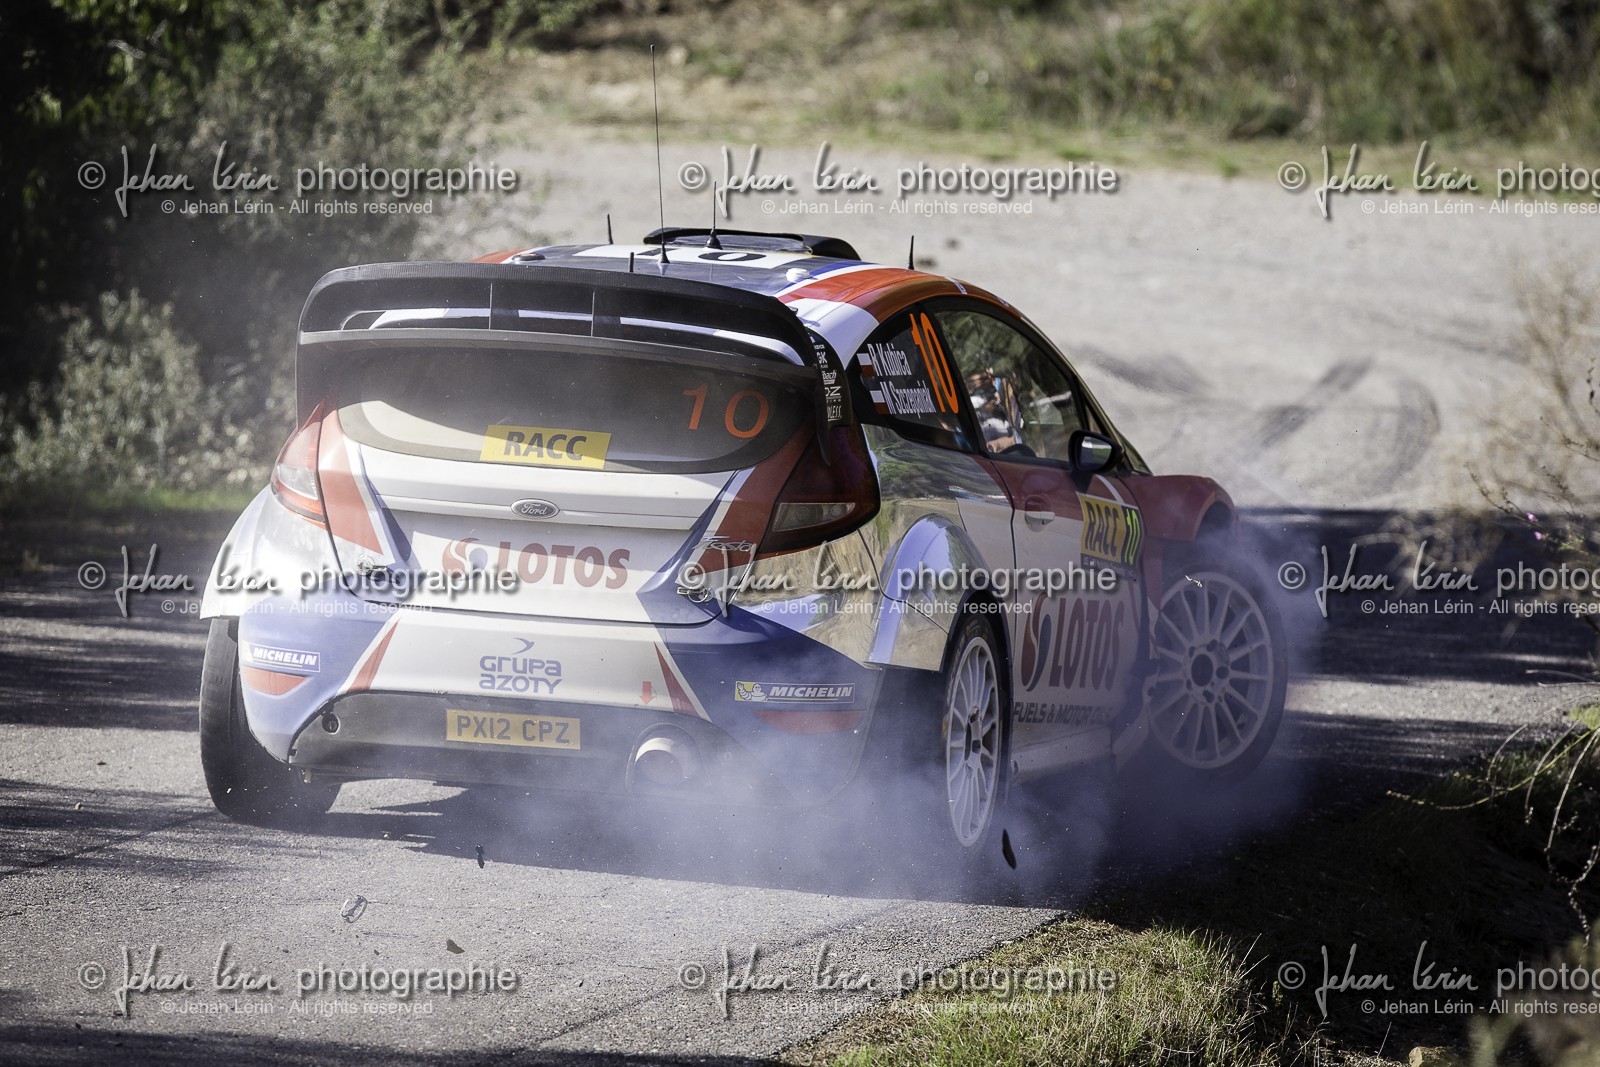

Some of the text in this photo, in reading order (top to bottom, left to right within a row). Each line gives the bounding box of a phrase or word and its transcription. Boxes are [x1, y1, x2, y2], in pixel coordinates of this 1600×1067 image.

[867, 343, 912, 376] R Kubica
[910, 312, 958, 414] 10
[683, 383, 769, 439] 10
[880, 381, 897, 414] M
[503, 431, 587, 461] RACC
[521, 503, 548, 515] Ford
[1085, 500, 1140, 566] RACC 10
[497, 541, 631, 590] LOTOS
[253, 647, 318, 666] MICHELIN
[1048, 597, 1125, 692] LOTOS
[769, 686, 853, 698] MICHELIN
[457, 714, 570, 744] PX12 CPZ
[1013, 702, 1047, 724] FUELS
